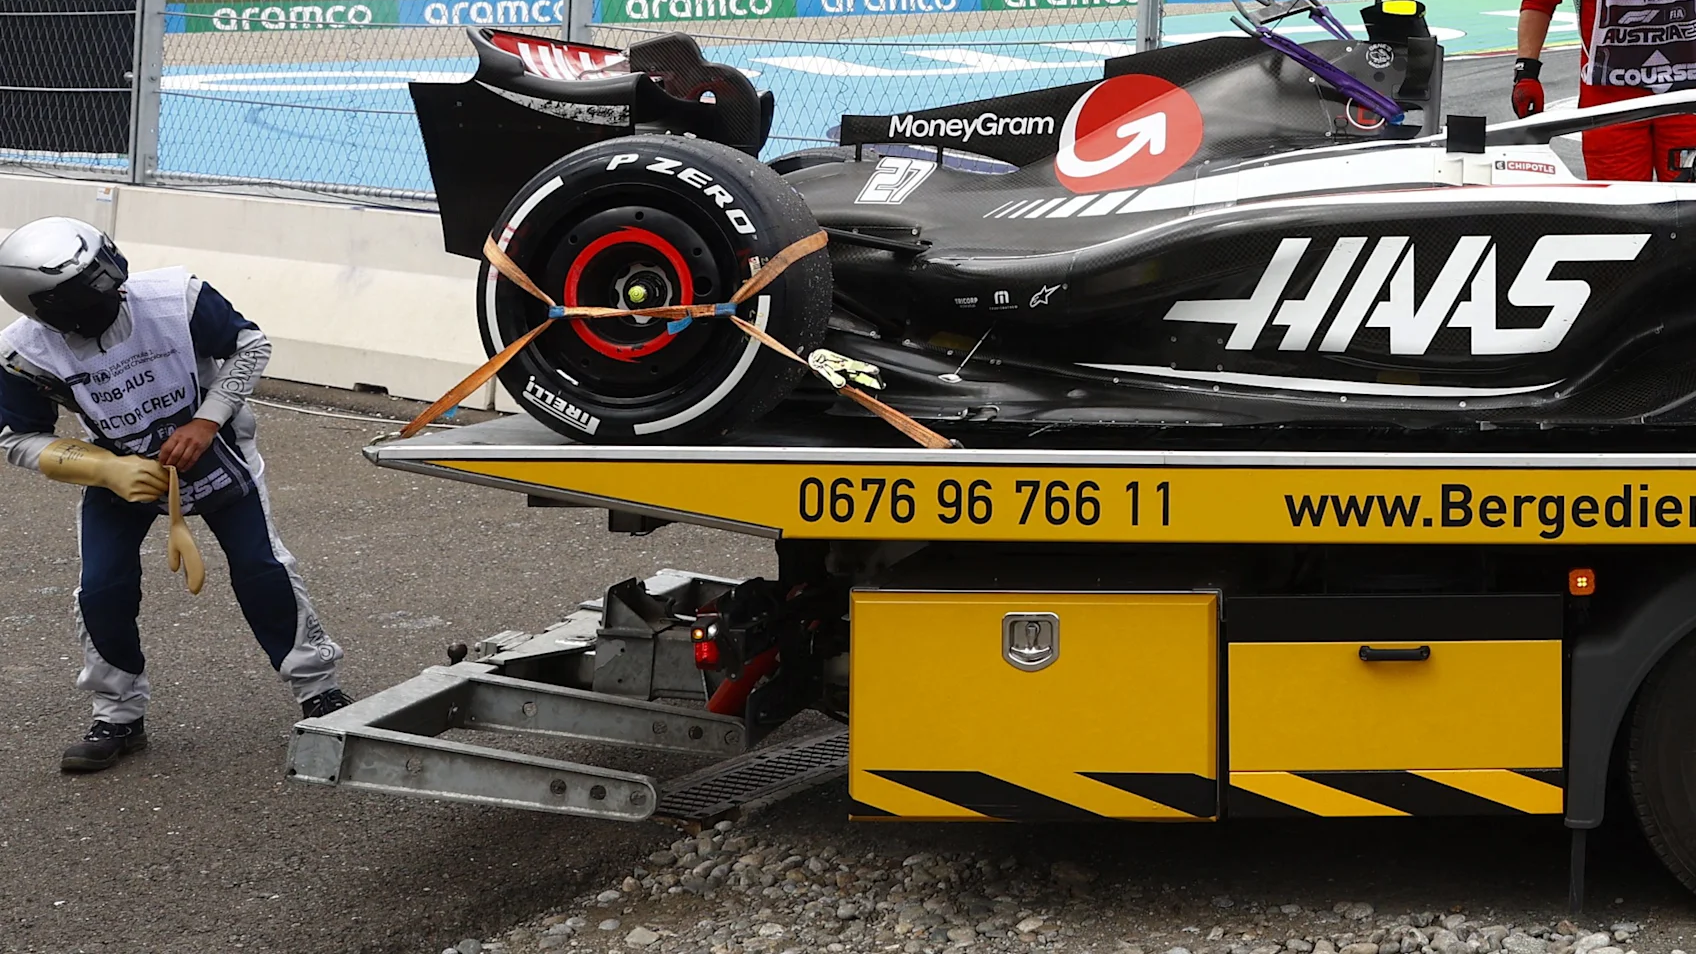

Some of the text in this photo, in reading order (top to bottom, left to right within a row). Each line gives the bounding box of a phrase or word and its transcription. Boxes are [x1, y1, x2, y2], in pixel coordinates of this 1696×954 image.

[212, 4, 373, 31] aramco
[888, 112, 1055, 143] MoneyGram
[854, 156, 937, 205] 27
[1508, 161, 1555, 174] CHIPOTLE
[606, 153, 757, 236] P ZERO
[1163, 234, 1652, 355] HAAS
[142, 387, 185, 415] CREW
[522, 375, 600, 436] PIRELLI
[798, 477, 1173, 526] 0676 96 766 11
